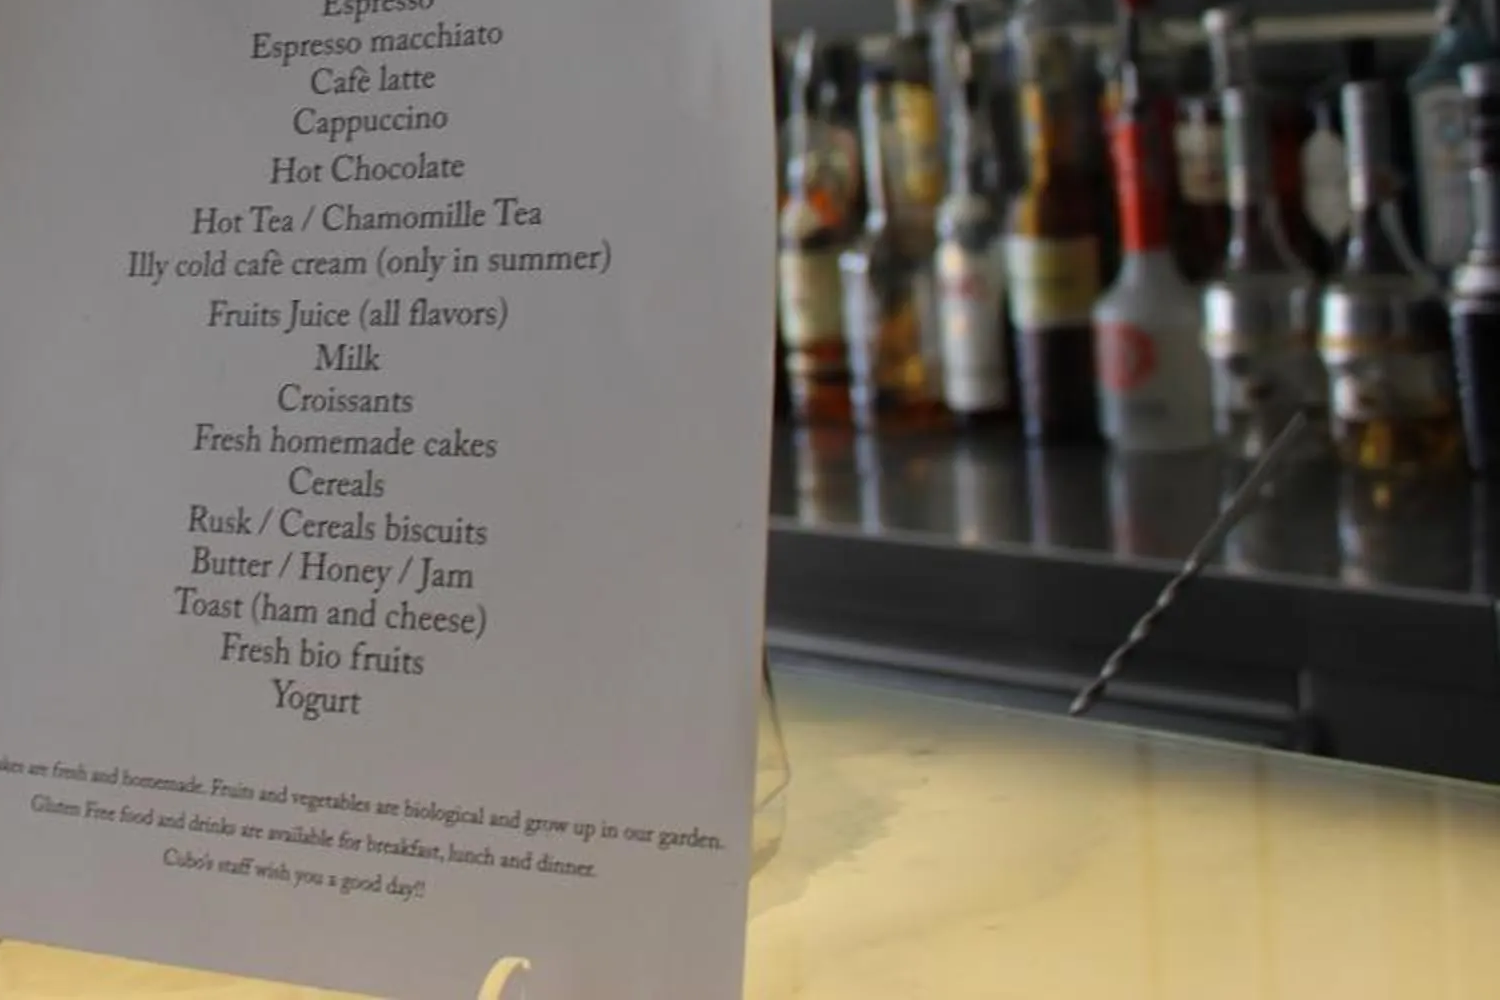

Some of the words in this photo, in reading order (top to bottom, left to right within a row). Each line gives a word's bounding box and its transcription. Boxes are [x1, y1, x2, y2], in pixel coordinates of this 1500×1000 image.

[250, 32, 362, 68] Espresso
[370, 21, 504, 53] macchiato
[378, 64, 436, 91] latte
[293, 105, 449, 143] Cappuccino
[269, 156, 324, 184] Hot
[331, 152, 465, 182] Chocolate
[191, 207, 244, 235] Hot
[249, 205, 294, 233] Tea
[322, 199, 486, 231] Chamomille
[492, 196, 542, 226] Tea
[127, 250, 169, 286] Illy
[175, 250, 227, 277] cold
[291, 257, 367, 275] cream
[376, 245, 448, 282] (only
[452, 247, 479, 273] in
[488, 239, 612, 274] summer)
[207, 299, 281, 327] Fruits
[283, 299, 351, 334] Juice
[359, 298, 401, 331] (all
[408, 296, 508, 331] flavors)
[313, 343, 382, 371] Milk
[277, 383, 414, 413] Croissants
[192, 423, 261, 452] Fresh
[269, 424, 415, 456] homemade
[423, 427, 498, 458] cakes
[288, 466, 385, 498] Cereals
[188, 504, 252, 535] Rusk
[279, 507, 376, 541] Cereals
[385, 511, 488, 546] biscuits
[191, 545, 273, 578] Butter
[299, 551, 393, 593] Honey
[415, 557, 473, 594] Jam
[174, 585, 244, 619] Toast
[251, 591, 318, 625] (ham
[327, 598, 377, 628] and
[385, 600, 487, 640] cheese)
[220, 631, 290, 665] Fresh
[299, 637, 341, 669] bio
[349, 641, 424, 675] fruits
[270, 677, 362, 721] Yogurt
[27, 764, 50, 777] are
[90, 766, 119, 785] and
[258, 785, 288, 804] and
[291, 792, 371, 813] vegetables
[375, 801, 400, 816] are
[403, 798, 484, 828] biological
[488, 809, 521, 829] and
[523, 818, 571, 837] grow
[573, 823, 596, 843] up
[600, 820, 619, 839] in
[623, 827, 655, 843] our
[83, 800, 116, 822] Free
[119, 805, 155, 826] food
[157, 811, 186, 830] and
[188, 814, 237, 837] drinks
[240, 824, 264, 839] are
[267, 826, 334, 848] available
[337, 830, 365, 852] for
[366, 833, 445, 863] breakfast,
[448, 842, 495, 866] lunch
[499, 851, 534, 871] and
[217, 857, 255, 876] staff
[256, 862, 291, 881] wish
[293, 870, 324, 888] you
[339, 874, 382, 895] good
